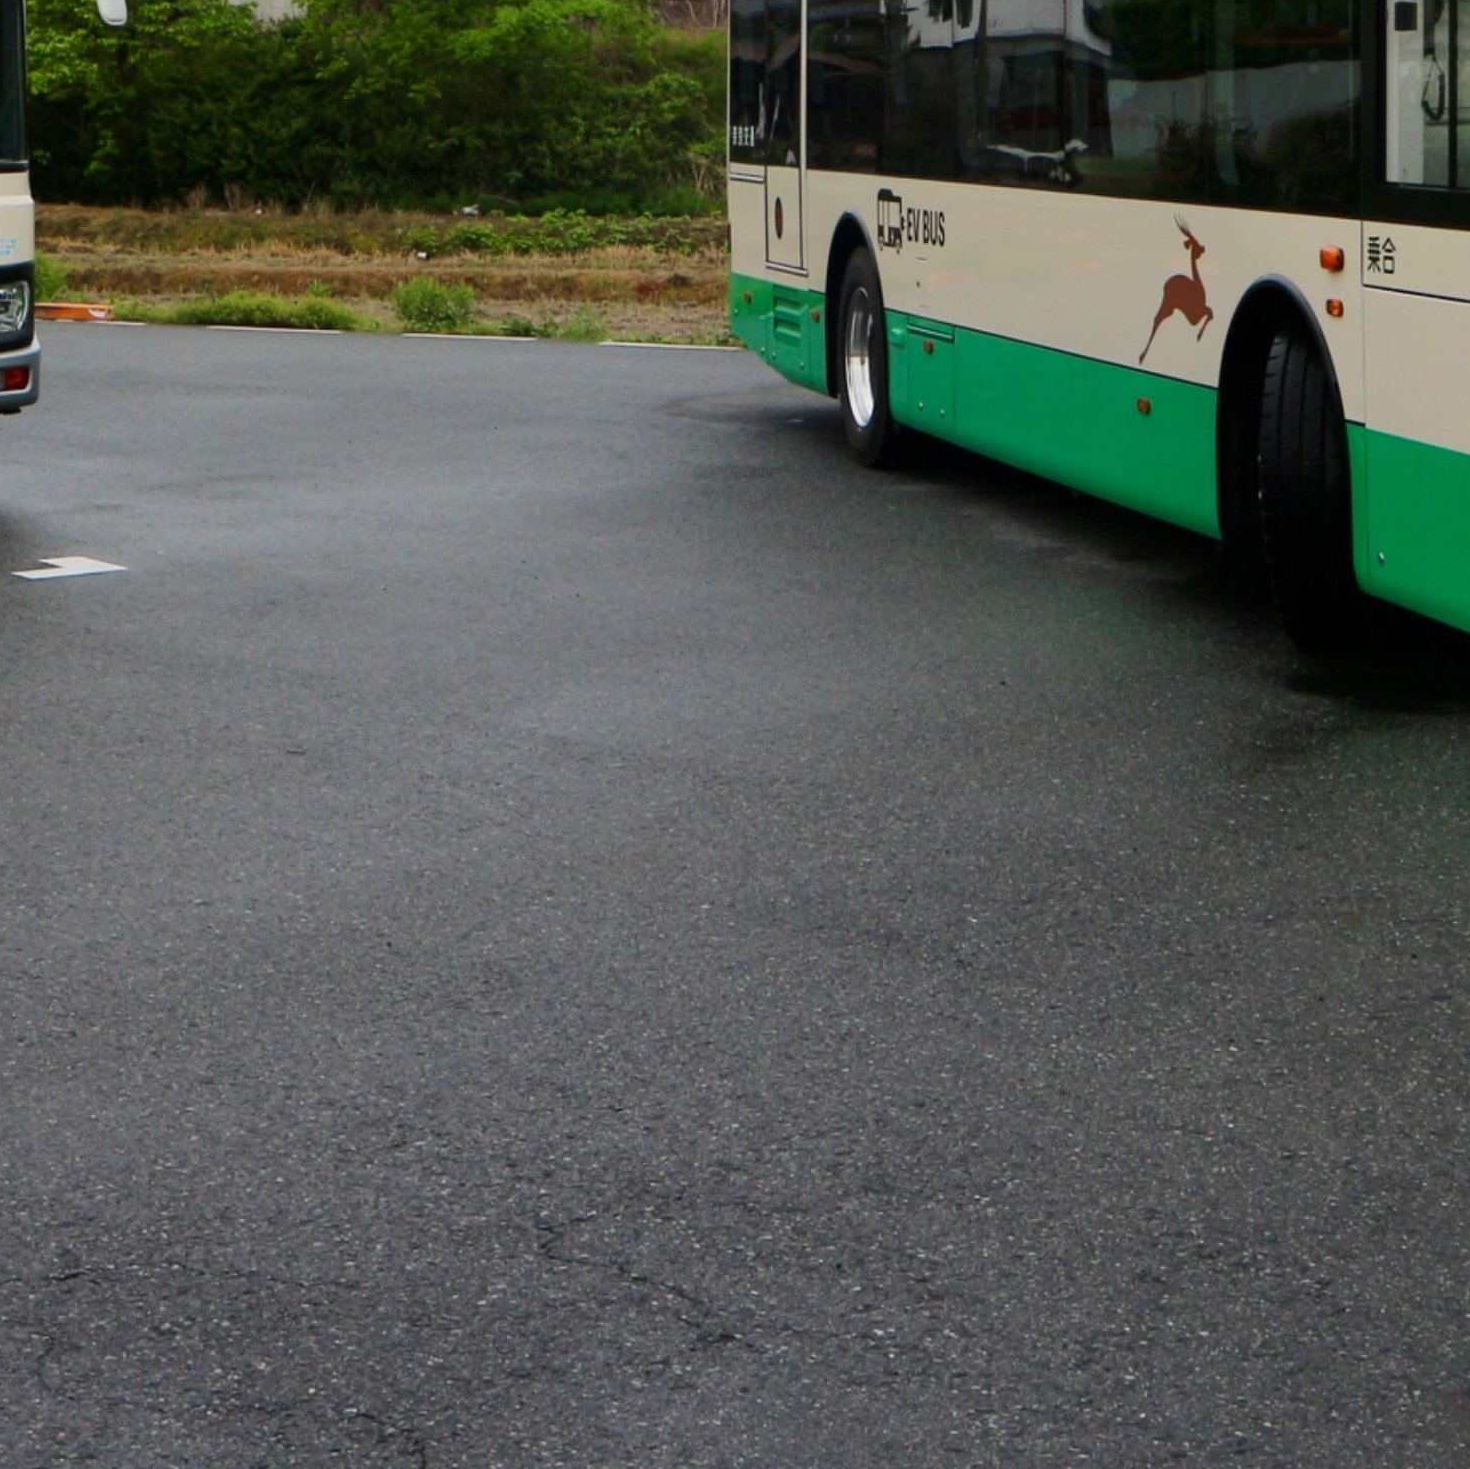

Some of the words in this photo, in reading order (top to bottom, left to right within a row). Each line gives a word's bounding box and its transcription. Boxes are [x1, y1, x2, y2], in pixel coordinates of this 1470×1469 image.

[906, 207, 921, 243] EV
[923, 209, 945, 247] BUS
[1367, 236, 1396, 274] 乗合
